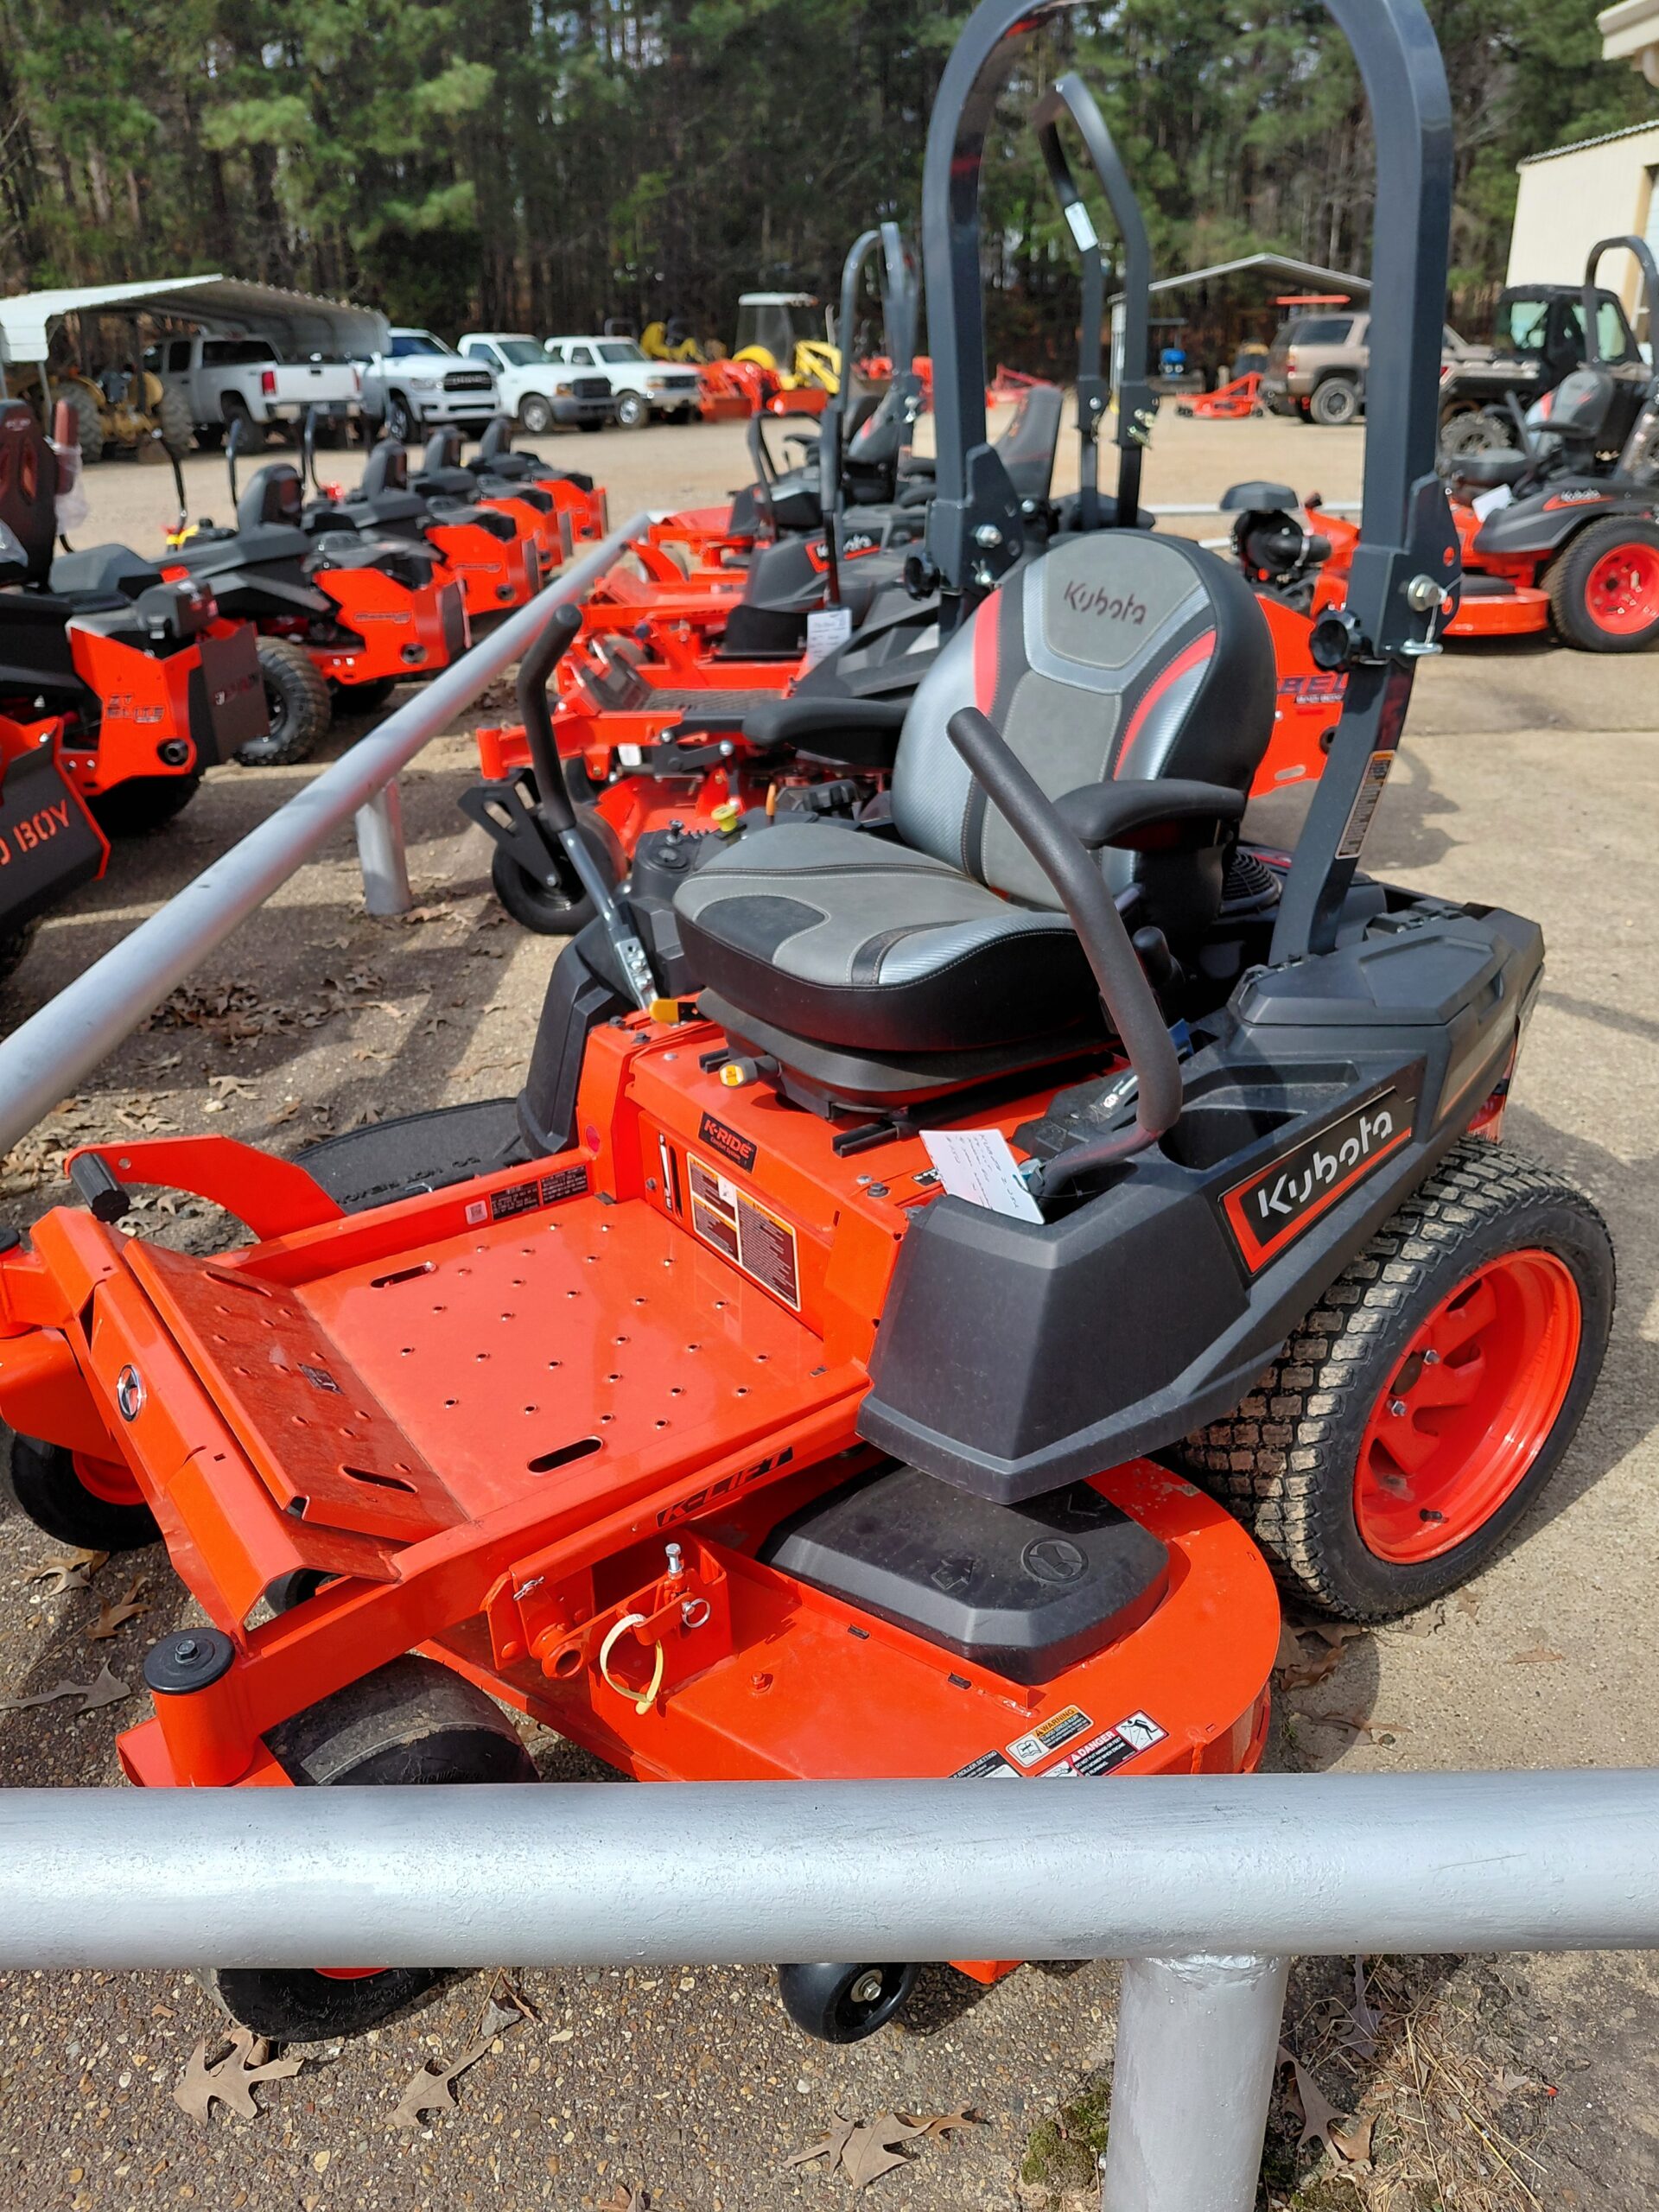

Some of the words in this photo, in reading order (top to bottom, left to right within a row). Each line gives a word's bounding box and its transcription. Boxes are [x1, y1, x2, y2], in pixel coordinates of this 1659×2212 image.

[1063, 580, 1147, 626] Kubota
[13, 799, 70, 854] BOY
[703, 1119, 753, 1159] K-RIDE
[1257, 1110, 1394, 1218] Kubota
[1040, 1708, 1075, 1732] WARNING
[1077, 1731, 1116, 1756] DANGER
[1088, 1752, 1096, 1761] PUT
[1096, 1746, 1107, 1755] HANDS
[1111, 1737, 1122, 1745] FEET
[1088, 1758, 1103, 1768] MOWER
[1102, 1750, 1113, 1758] WHEN
[1111, 1742, 1126, 1752] ENGINE
[957, 1763, 977, 1777] ROLLER
[976, 1751, 998, 1765] SETTING
